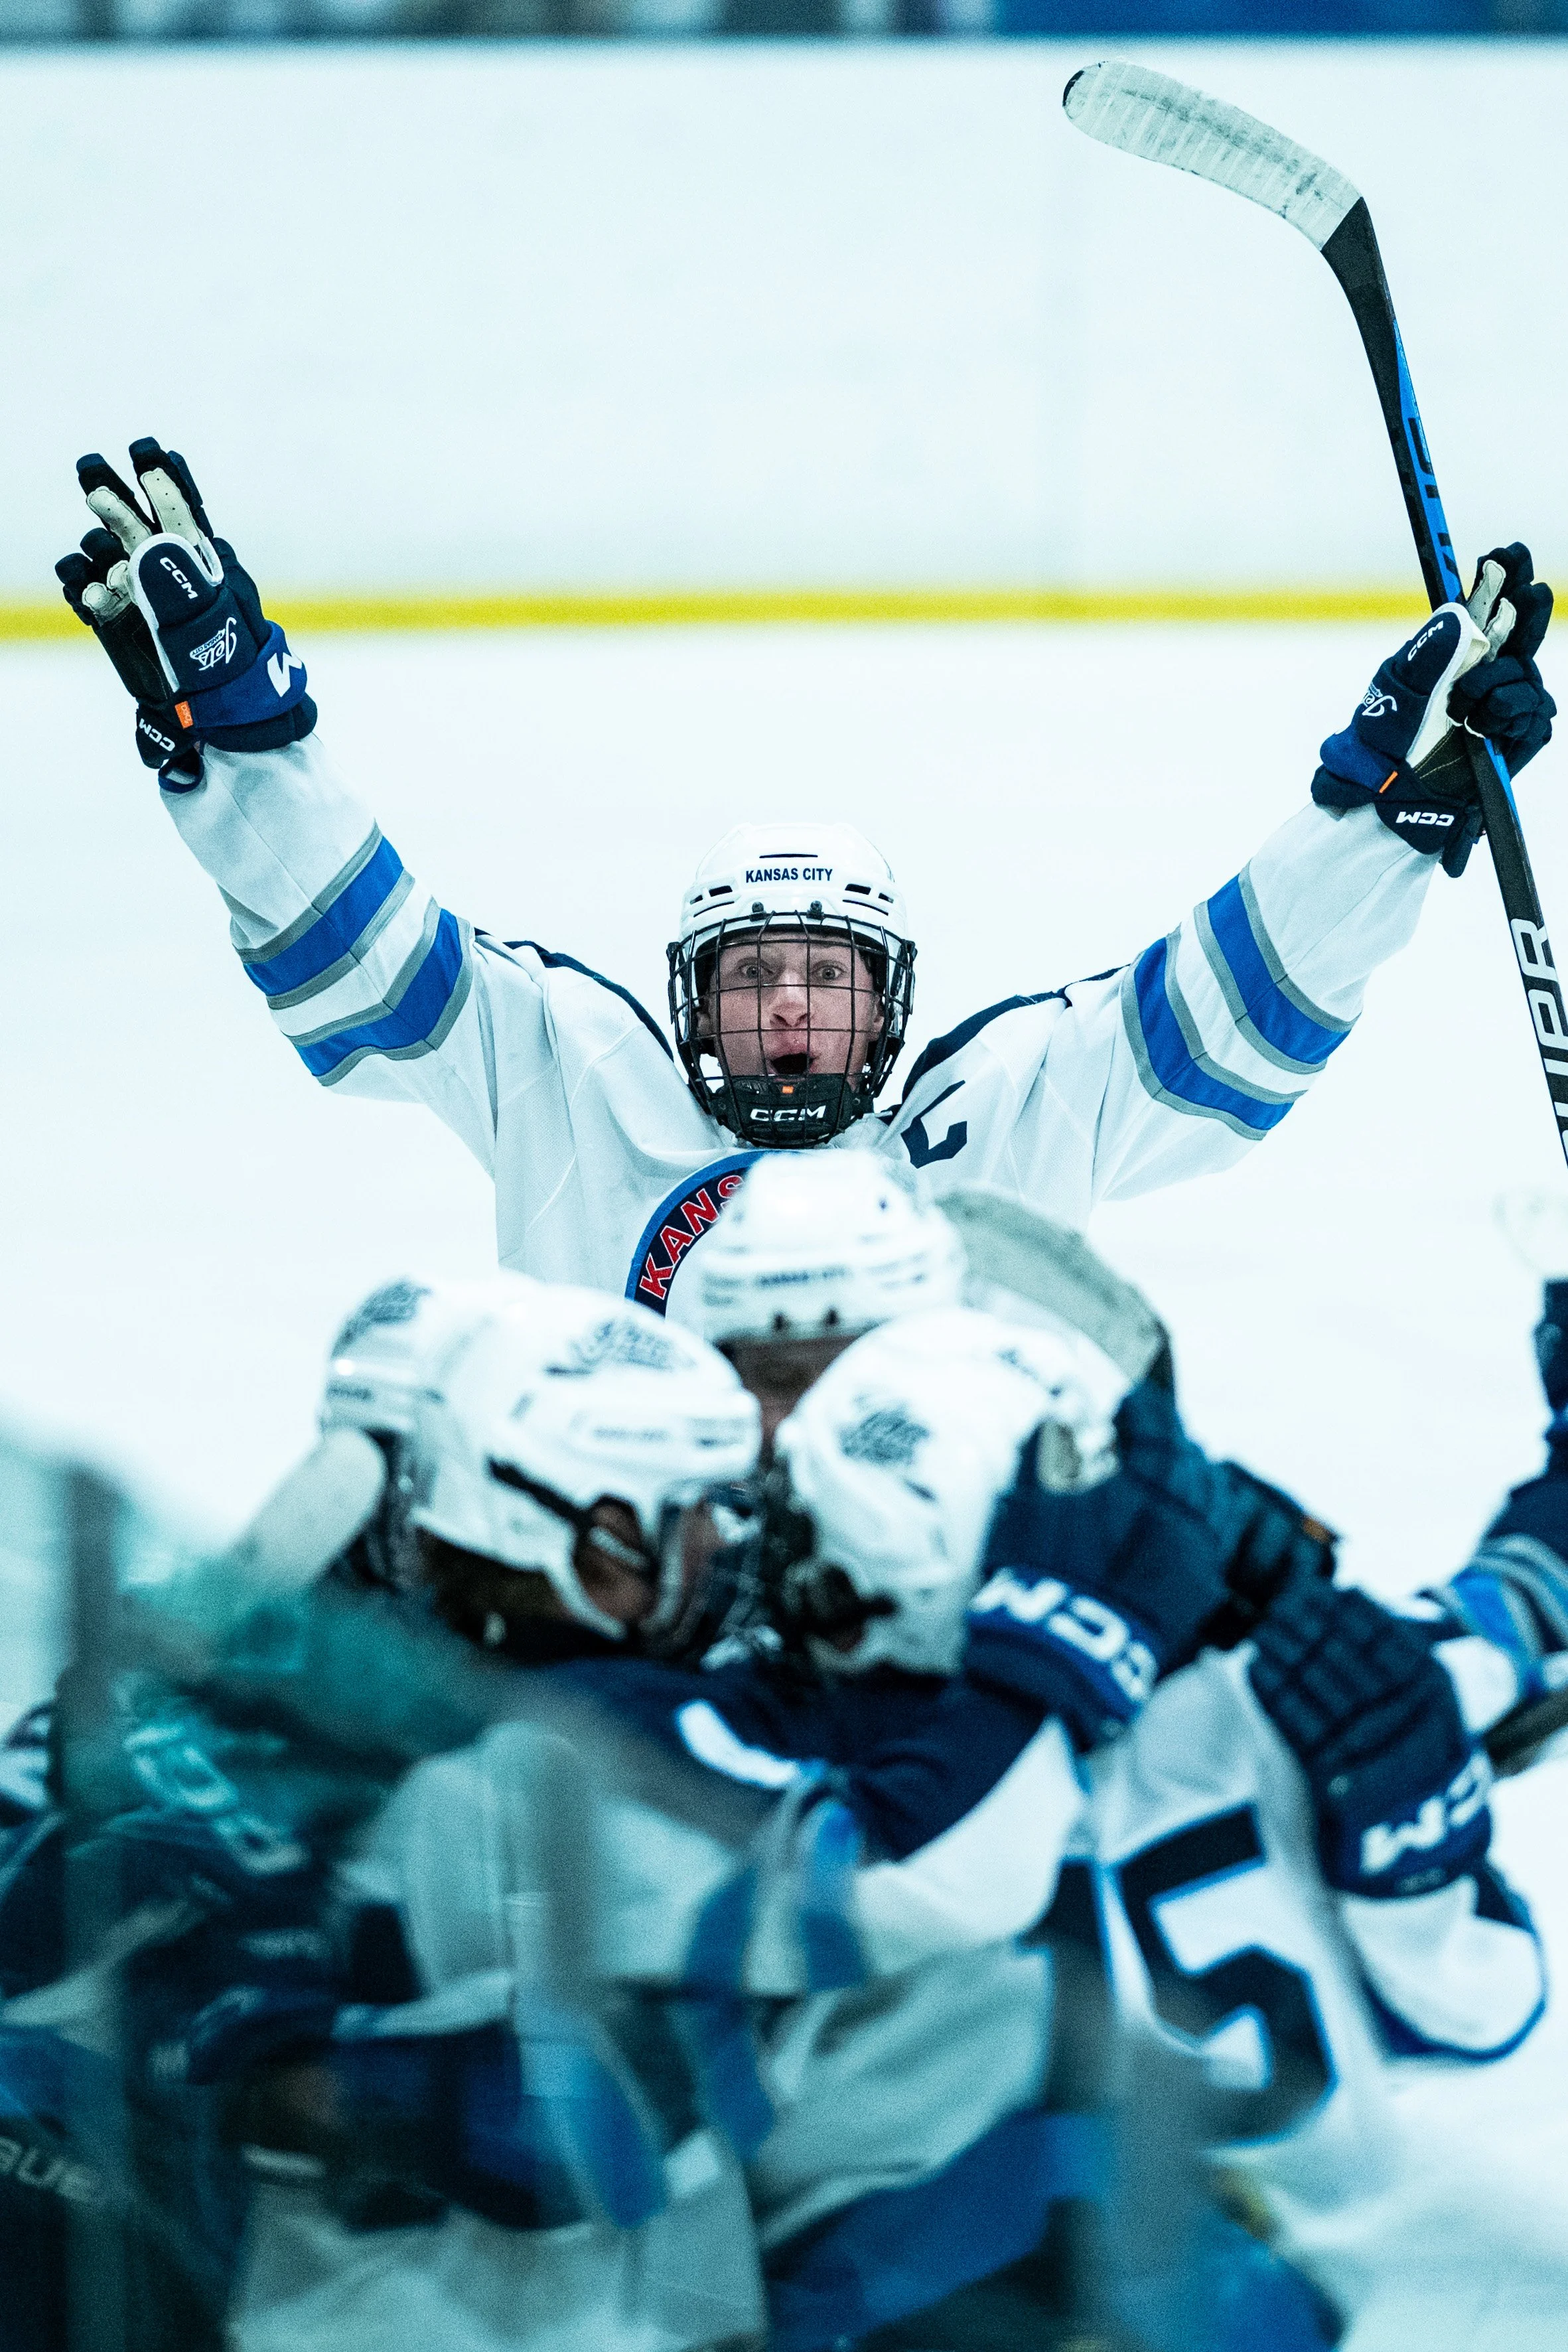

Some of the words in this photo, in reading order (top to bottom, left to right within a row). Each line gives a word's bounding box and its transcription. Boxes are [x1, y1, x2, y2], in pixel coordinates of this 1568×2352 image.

[160, 557, 198, 599] CCM
[190, 645, 204, 656] CITY
[197, 617, 237, 671] Jets
[203, 631, 224, 648] KANSAS
[1407, 620, 1443, 661] CCM
[139, 718, 175, 751] CCM
[1395, 810, 1454, 827] CCM
[746, 867, 798, 883] KANSAS
[803, 867, 833, 881] CITY
[750, 1104, 826, 1122] CCM
[900, 1079, 967, 1169] C
